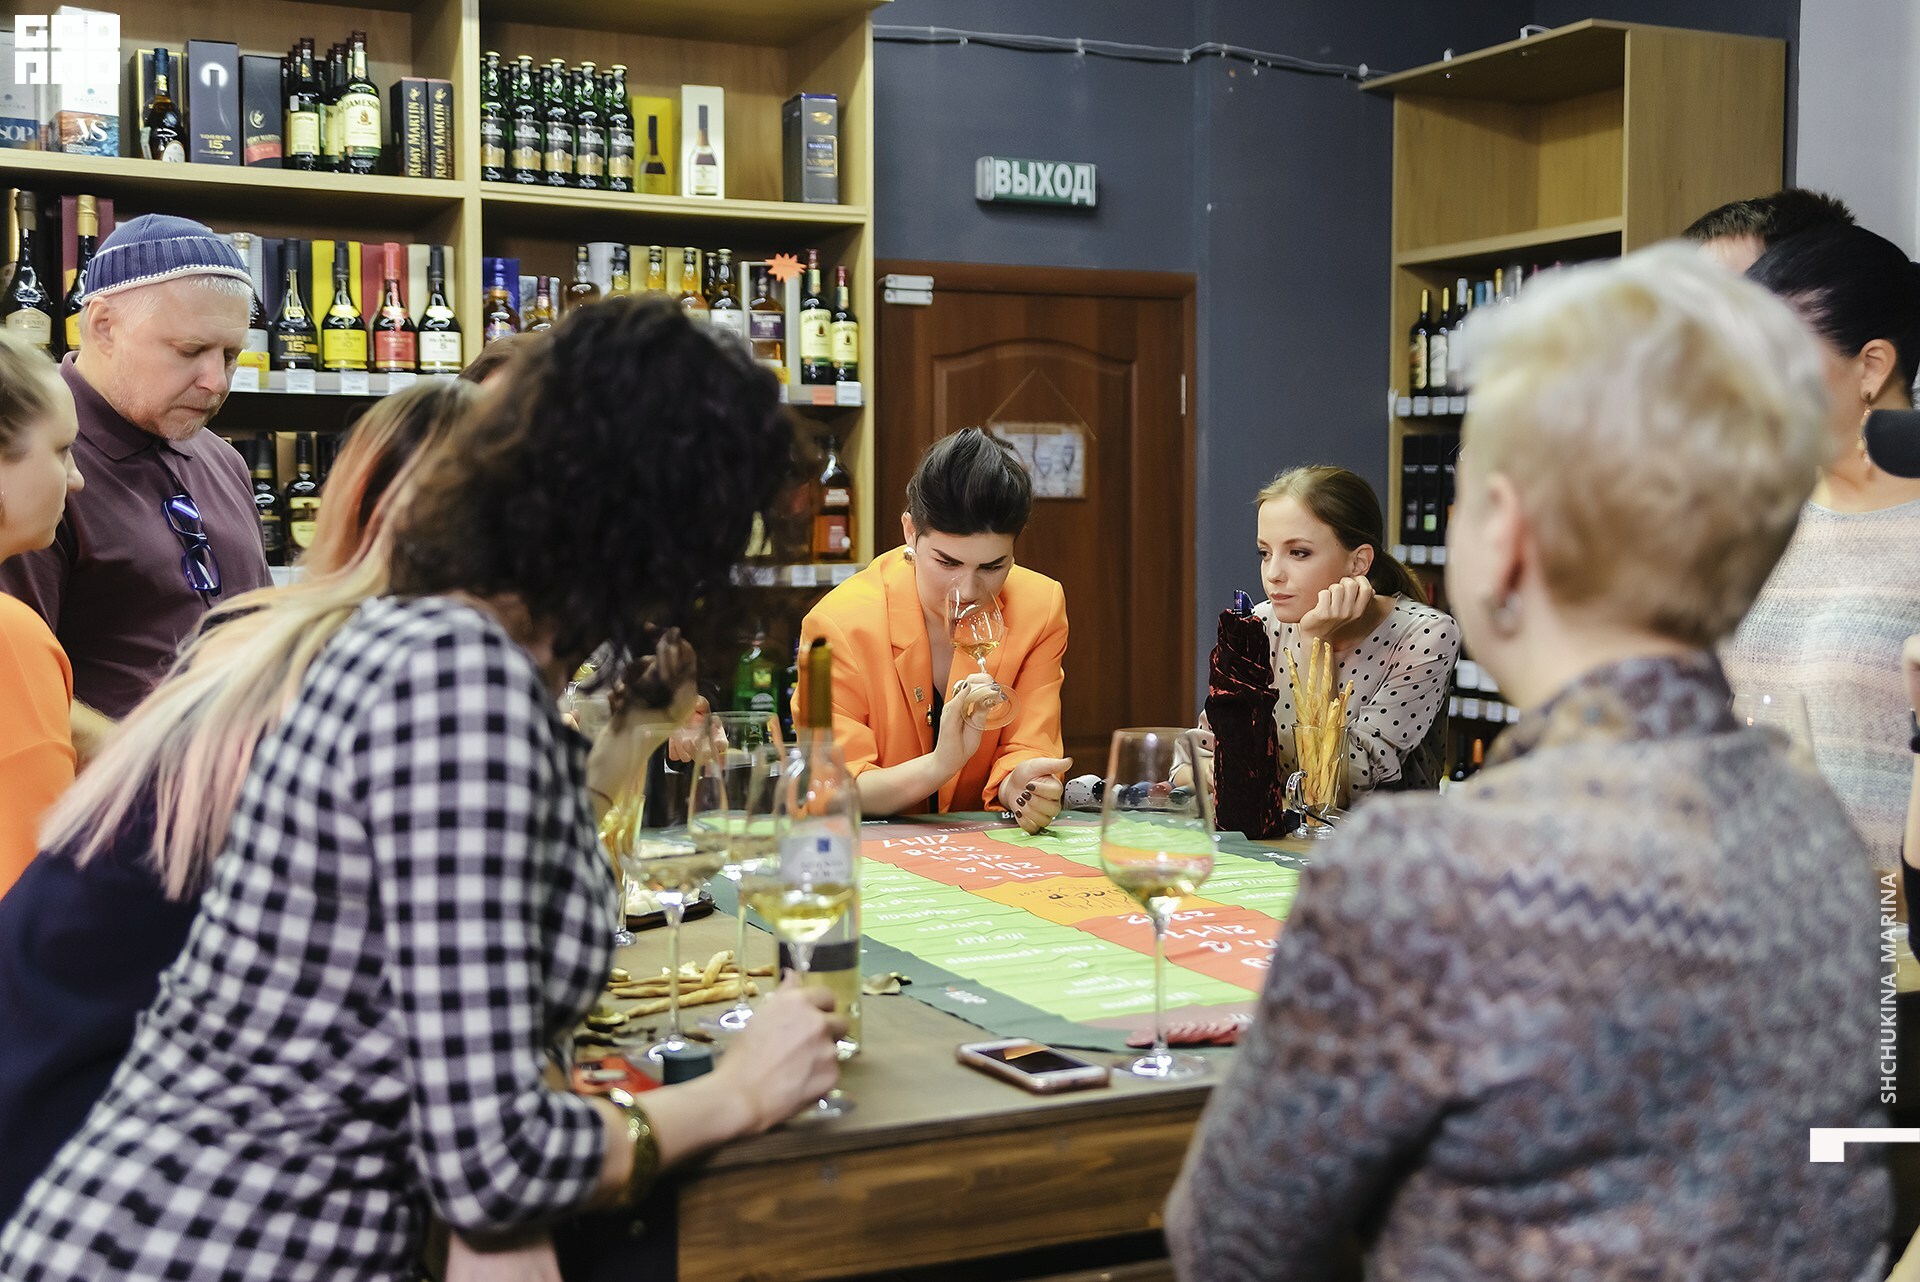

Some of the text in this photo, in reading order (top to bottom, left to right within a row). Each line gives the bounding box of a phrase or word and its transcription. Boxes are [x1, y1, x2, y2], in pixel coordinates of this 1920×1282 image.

[208, 140, 225, 150] 15
[994, 159, 1096, 207] ВЫХОД
[287, 341, 306, 352] 15
